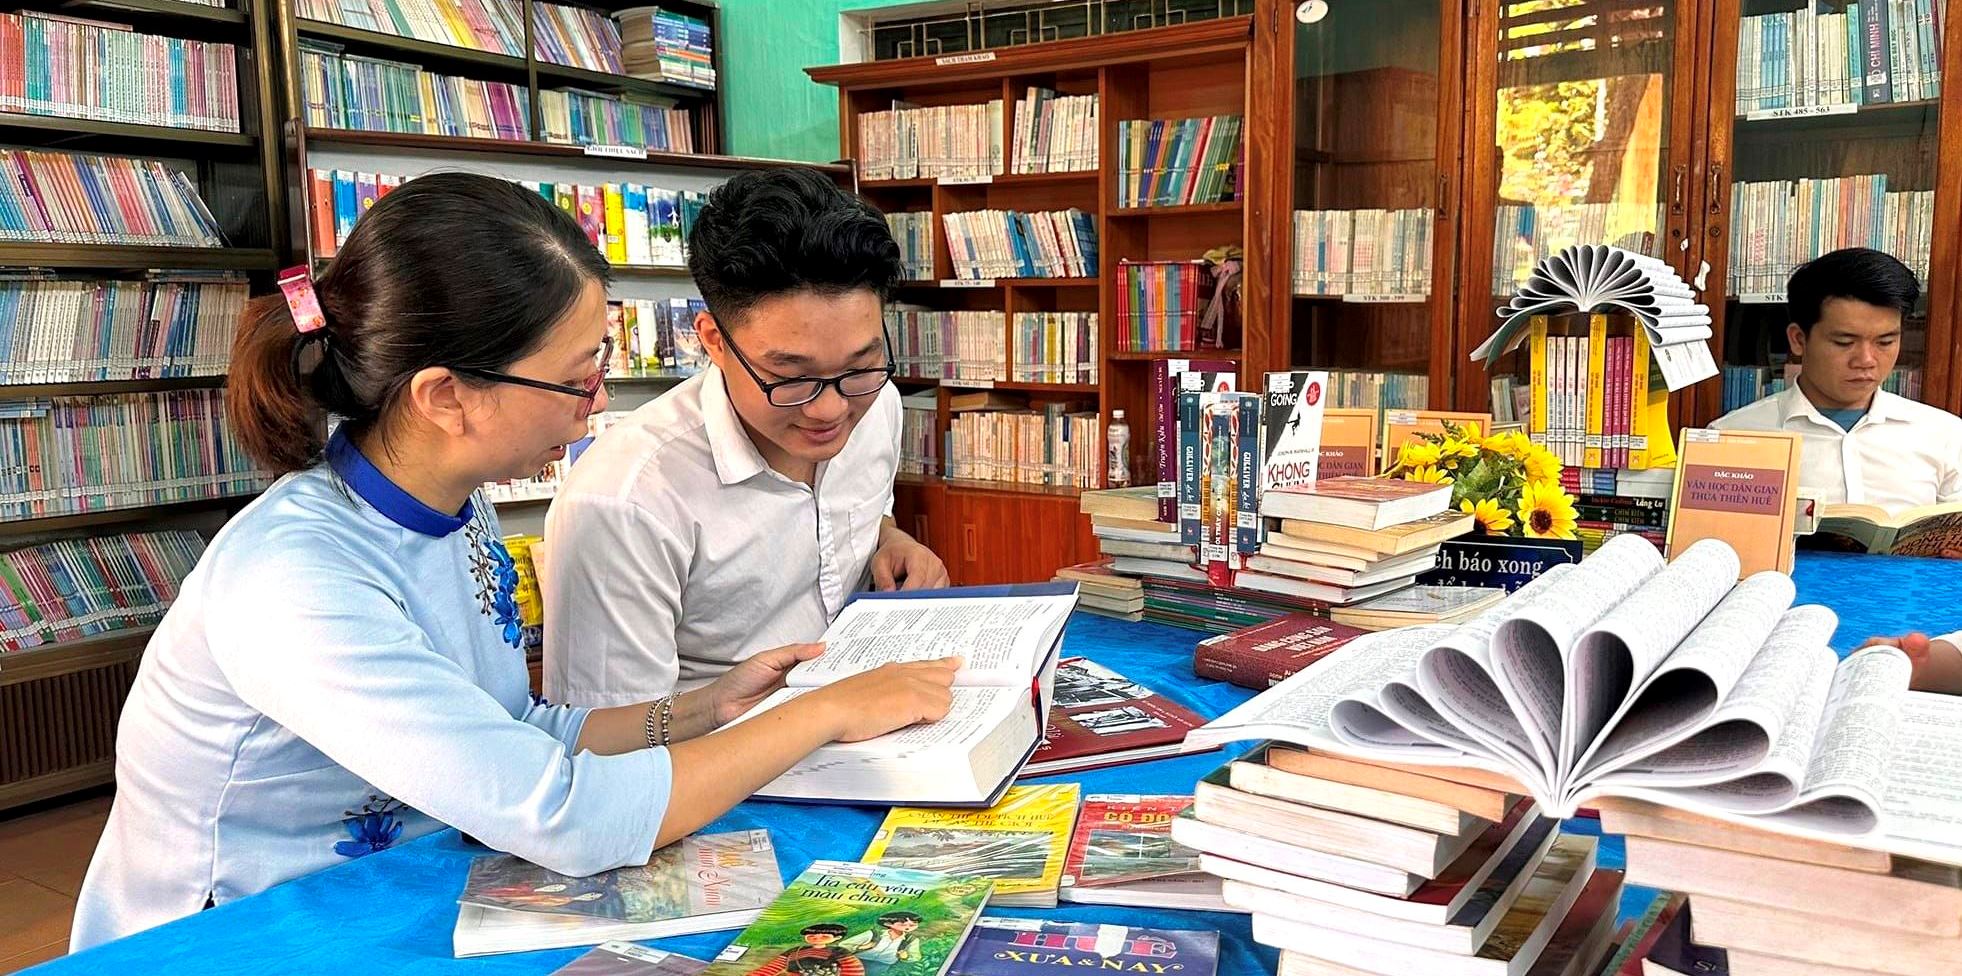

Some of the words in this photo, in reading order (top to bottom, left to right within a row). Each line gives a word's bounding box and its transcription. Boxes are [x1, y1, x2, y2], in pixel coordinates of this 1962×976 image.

[1870, 24, 1880, 48] MINH
[1270, 394, 1297, 406] GOING
[1243, 452, 1251, 488] GULLIVER
[1268, 461, 1310, 484] KHÔNG
[1687, 480, 1706, 489] VĂN
[1708, 482, 1730, 492] HỌC
[1732, 483, 1752, 492] DÂN
[1754, 486, 1779, 494] GIAN
[1720, 492, 1748, 504] THIÊN
[1752, 495, 1772, 506] HUẾ
[1458, 550, 1492, 572] báo
[1498, 560, 1544, 579] xong
[800, 888, 843, 900] màu
[848, 889, 900, 905] chàm
[815, 874, 840, 888] Tia
[846, 878, 880, 892] cầu
[884, 883, 926, 899] vồng
[994, 950, 1073, 966] XƯA
[1078, 958, 1094, 966] &
[1101, 958, 1184, 974] NAY
